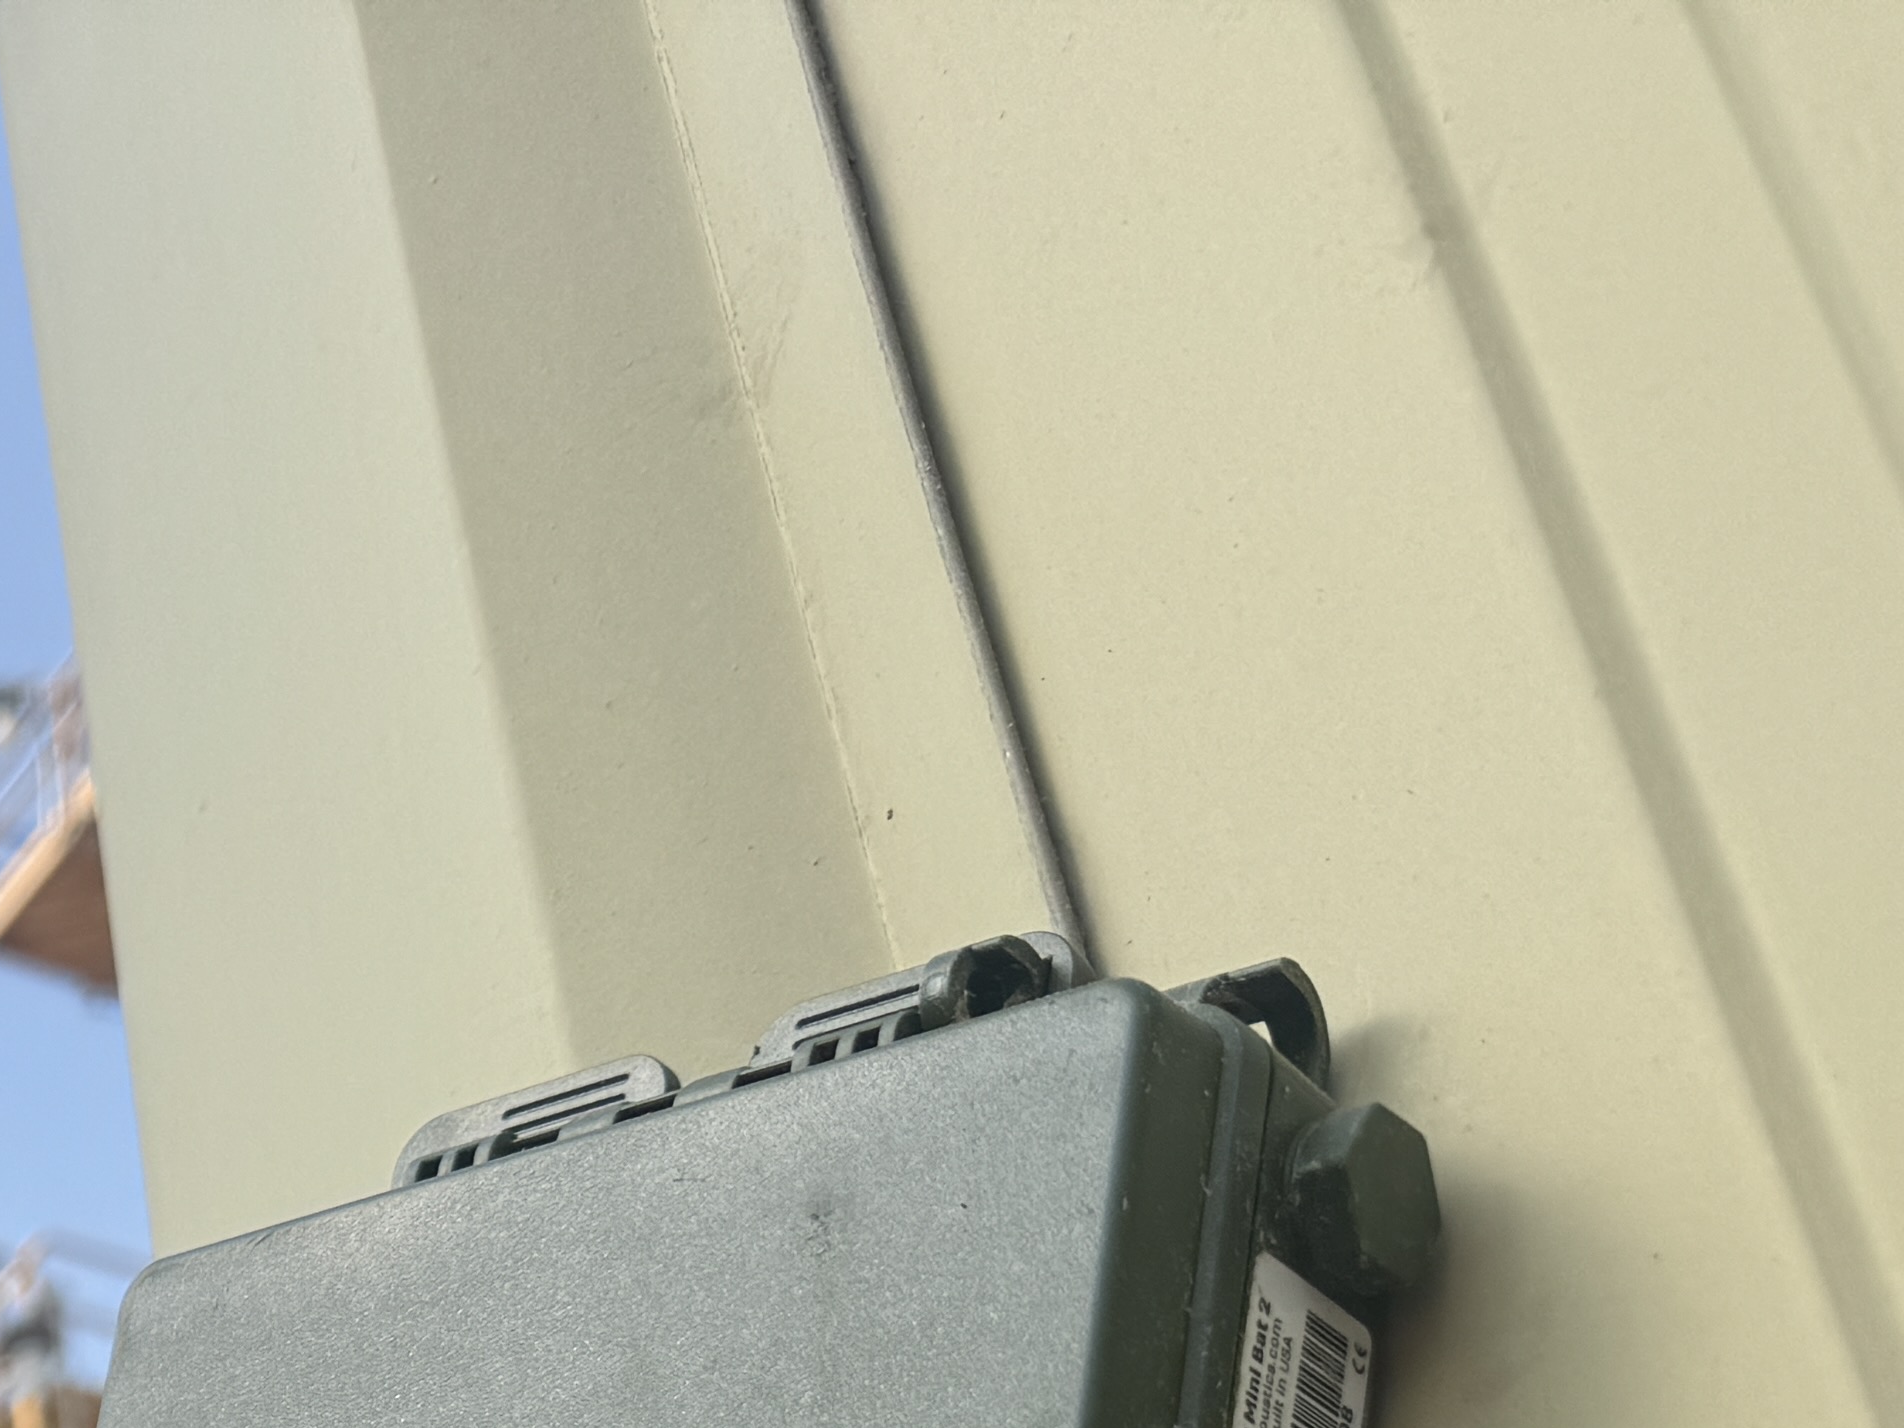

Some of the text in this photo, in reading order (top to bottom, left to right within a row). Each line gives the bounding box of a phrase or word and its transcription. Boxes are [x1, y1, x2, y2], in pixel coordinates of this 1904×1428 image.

[1258, 1297, 1271, 1317] 2
[1253, 1319, 1269, 1364] Bat
[1279, 1336, 1293, 1374] USA
[1243, 1366, 1261, 1425] Mini
[1275, 1378, 1287, 1397] in
